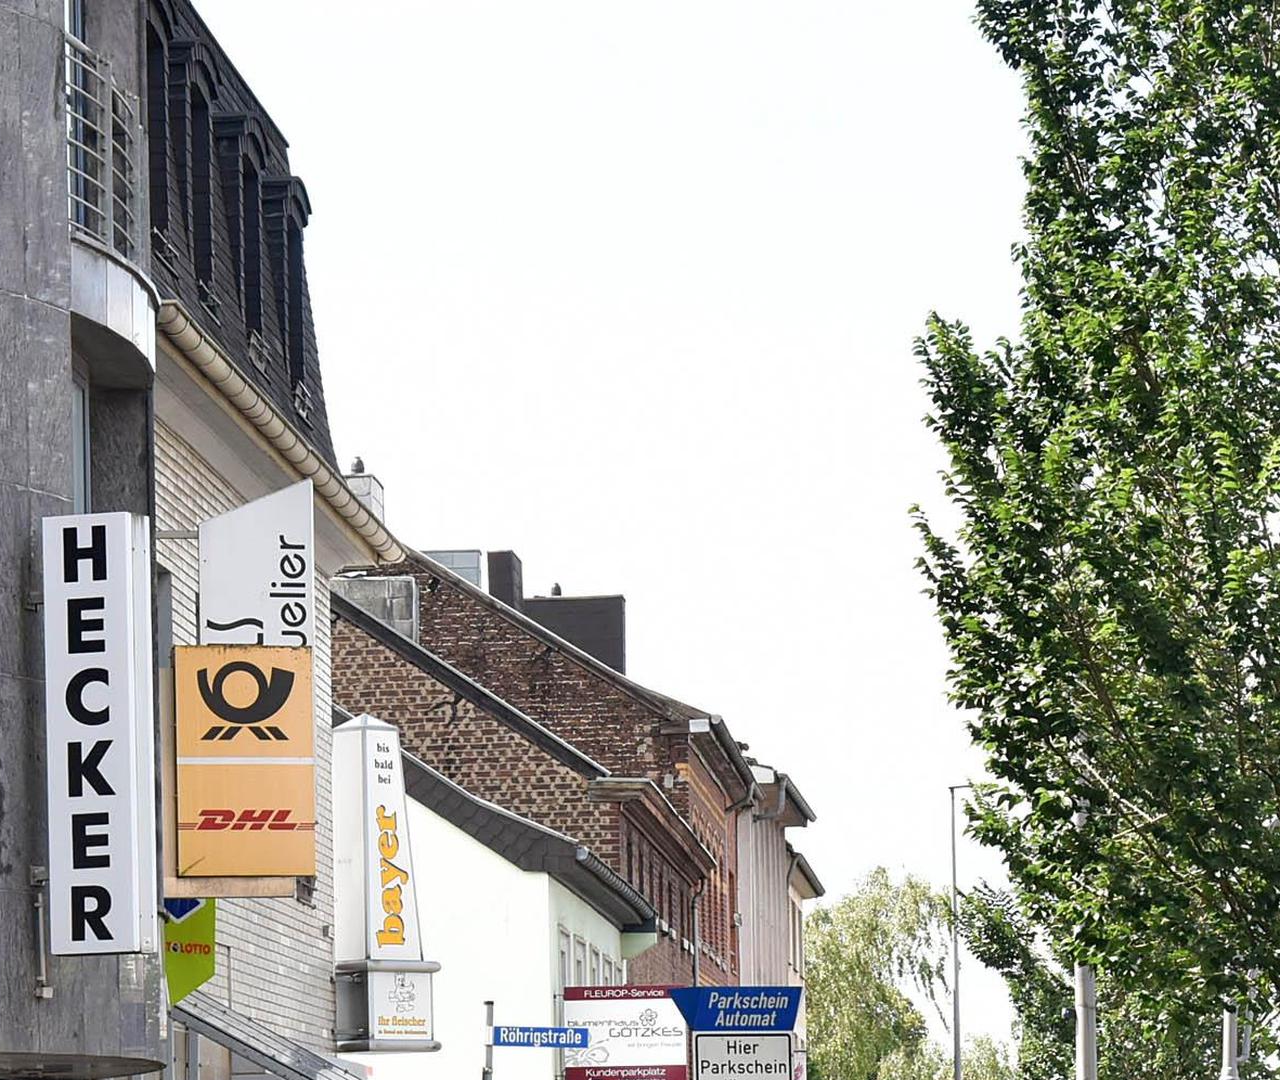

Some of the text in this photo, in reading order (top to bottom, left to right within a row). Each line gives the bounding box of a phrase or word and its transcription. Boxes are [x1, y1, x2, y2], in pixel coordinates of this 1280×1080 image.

[63, 525, 115, 941] HECKER
[377, 743, 390, 753] bis
[374, 758, 393, 770] bald
[378, 774, 391, 785] bei
[197, 809, 298, 831] DHL
[376, 805, 409, 948] bayer
[584, 988, 664, 998] FLEUROP-Service
[708, 992, 789, 1009] Parkschein
[715, 1010, 777, 1027] Automat
[500, 1027, 582, 1047] Röhrigstraße
[727, 1040, 759, 1054] Hier
[585, 1068, 666, 1077] Kundenparkplatz
[701, 1059, 787, 1074] Parkschein
